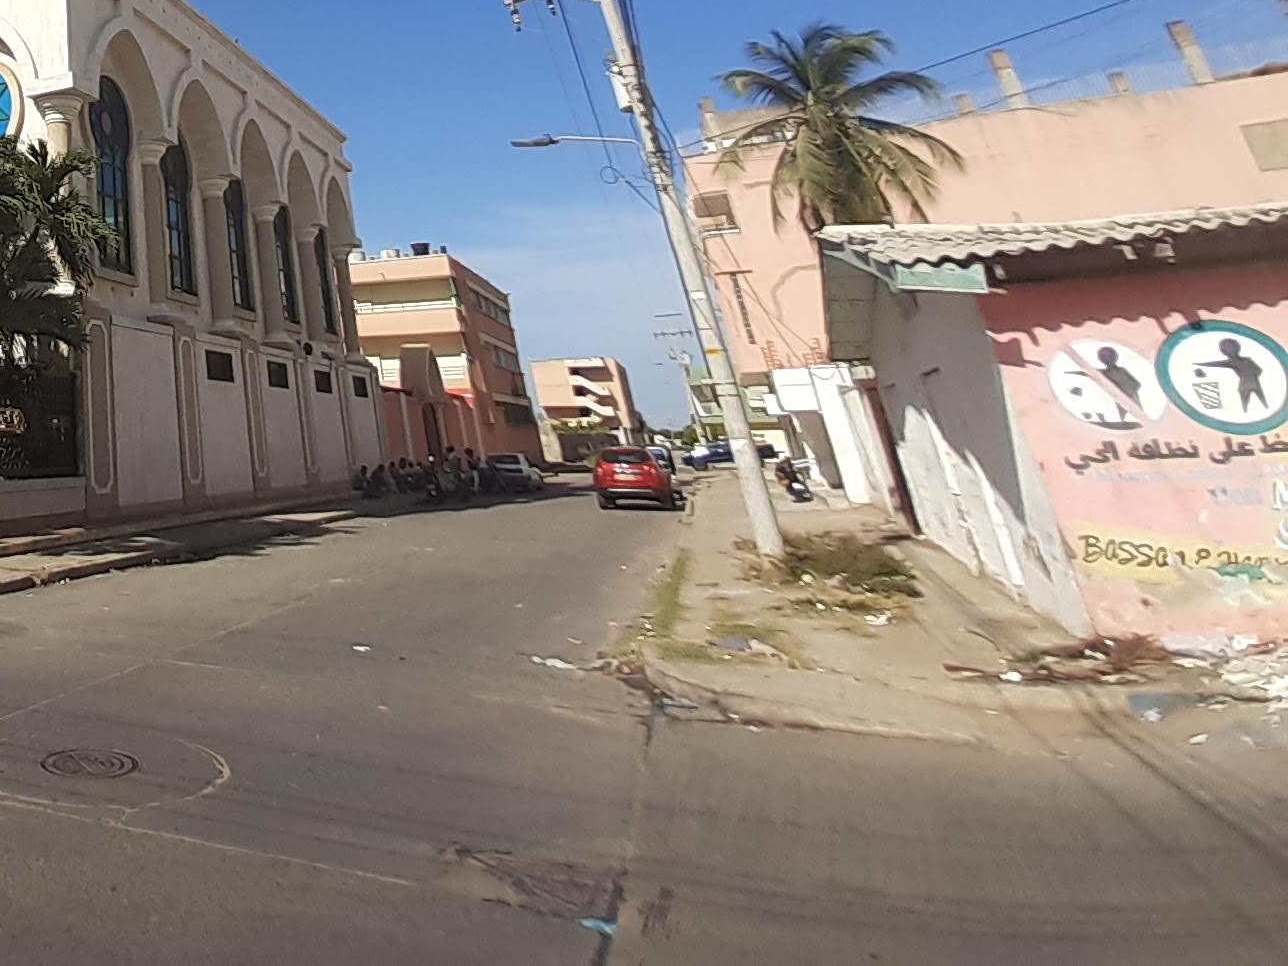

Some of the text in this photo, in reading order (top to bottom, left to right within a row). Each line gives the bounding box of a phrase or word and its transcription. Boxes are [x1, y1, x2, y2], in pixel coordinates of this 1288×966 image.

[1064, 440, 1120, 476] الحي
[1127, 437, 1200, 460] نظافة
[1209, 436, 1255, 464] على
